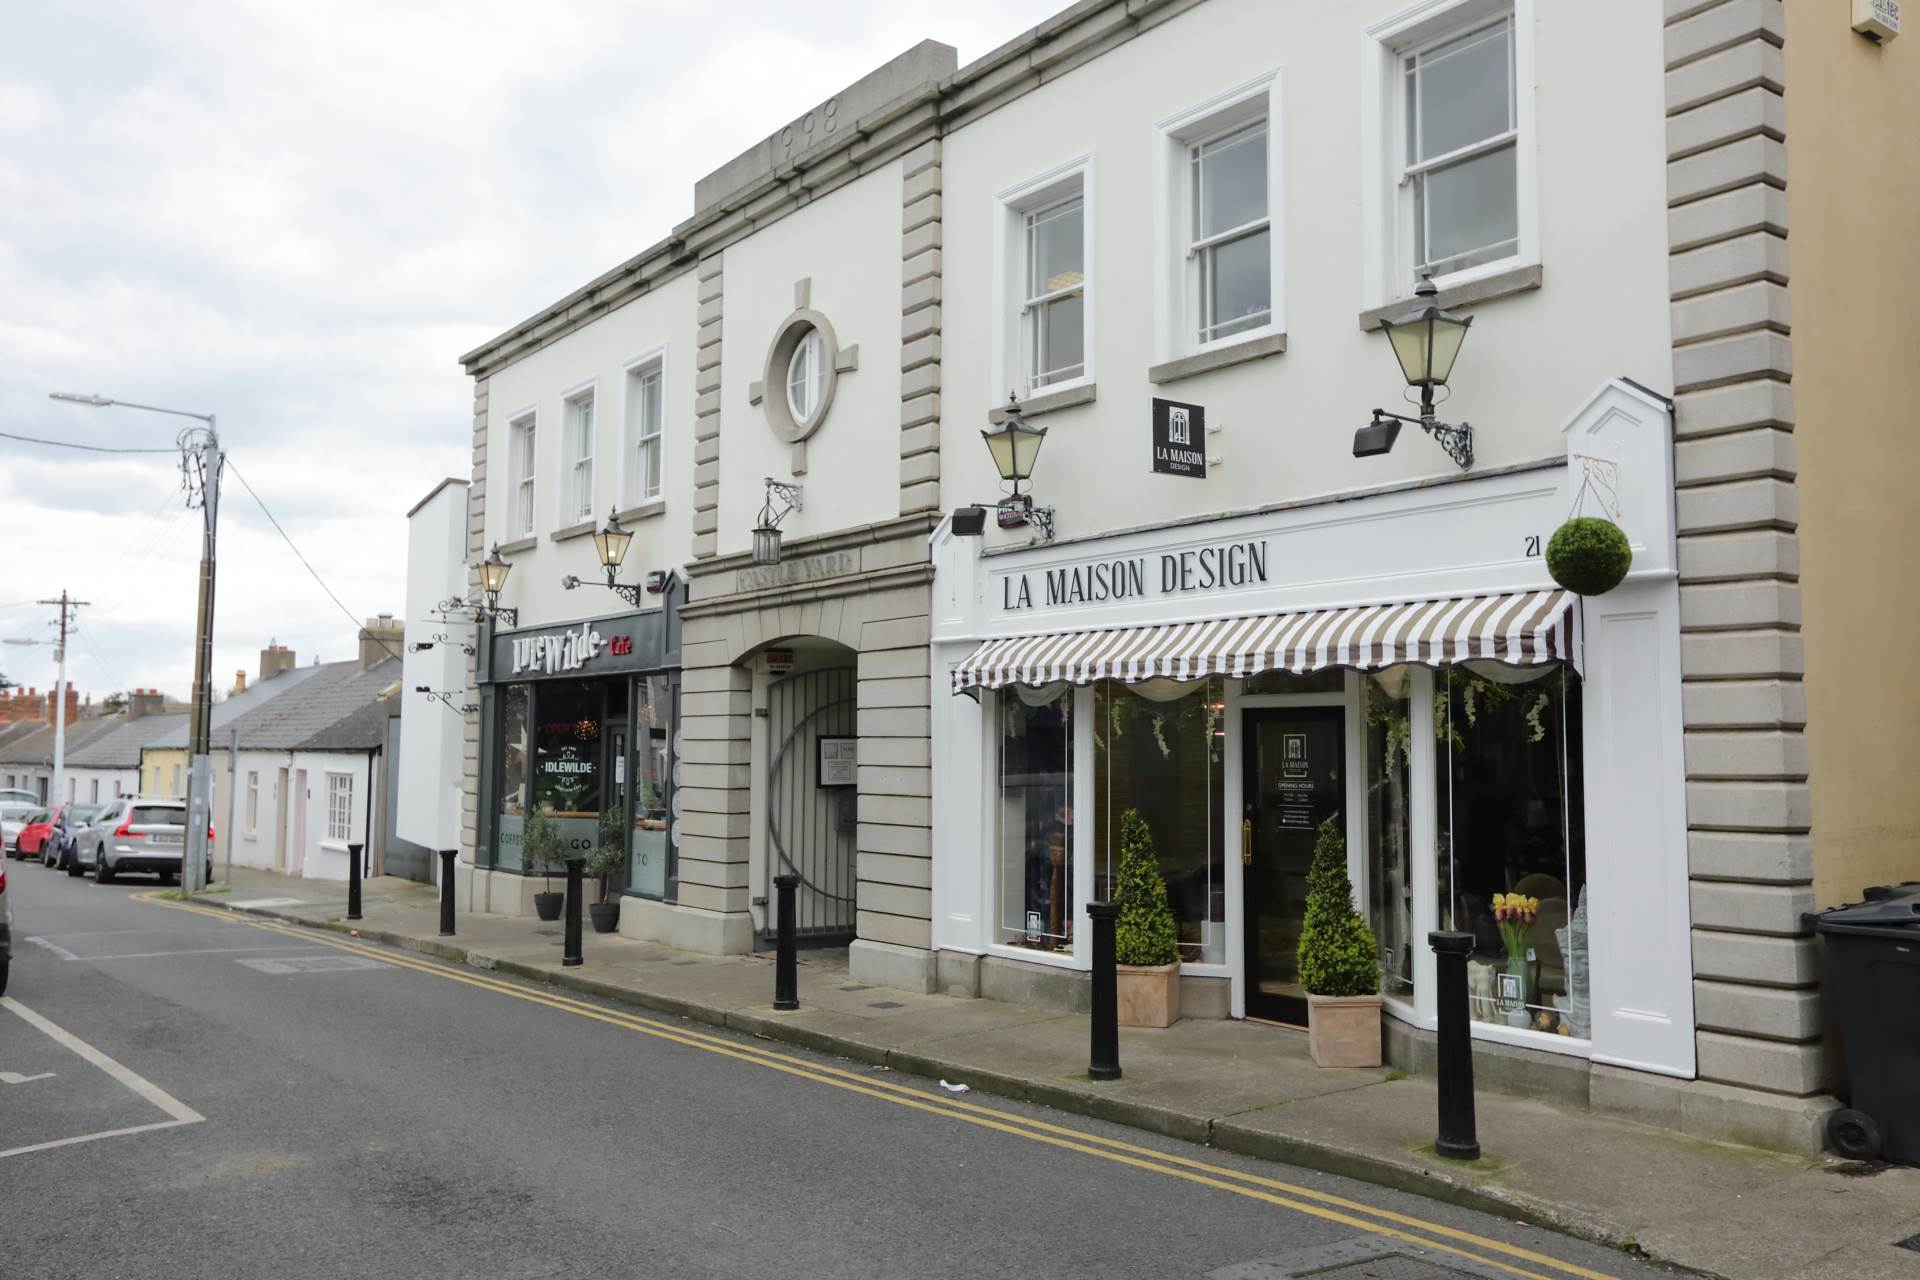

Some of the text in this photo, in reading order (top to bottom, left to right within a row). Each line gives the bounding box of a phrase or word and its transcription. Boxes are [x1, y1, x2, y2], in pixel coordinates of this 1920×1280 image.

[769, 97, 838, 170] 1998
[1156, 446, 1202, 465] LA MAISON
[1170, 462, 1190, 471] DESIGN
[1525, 535, 1540, 557] 21
[1003, 541, 1267, 610] LA MAISON DESIGN
[545, 761, 592, 773] IDLEWILDE
[571, 838, 591, 850] GO
[637, 853, 648, 866] TO
